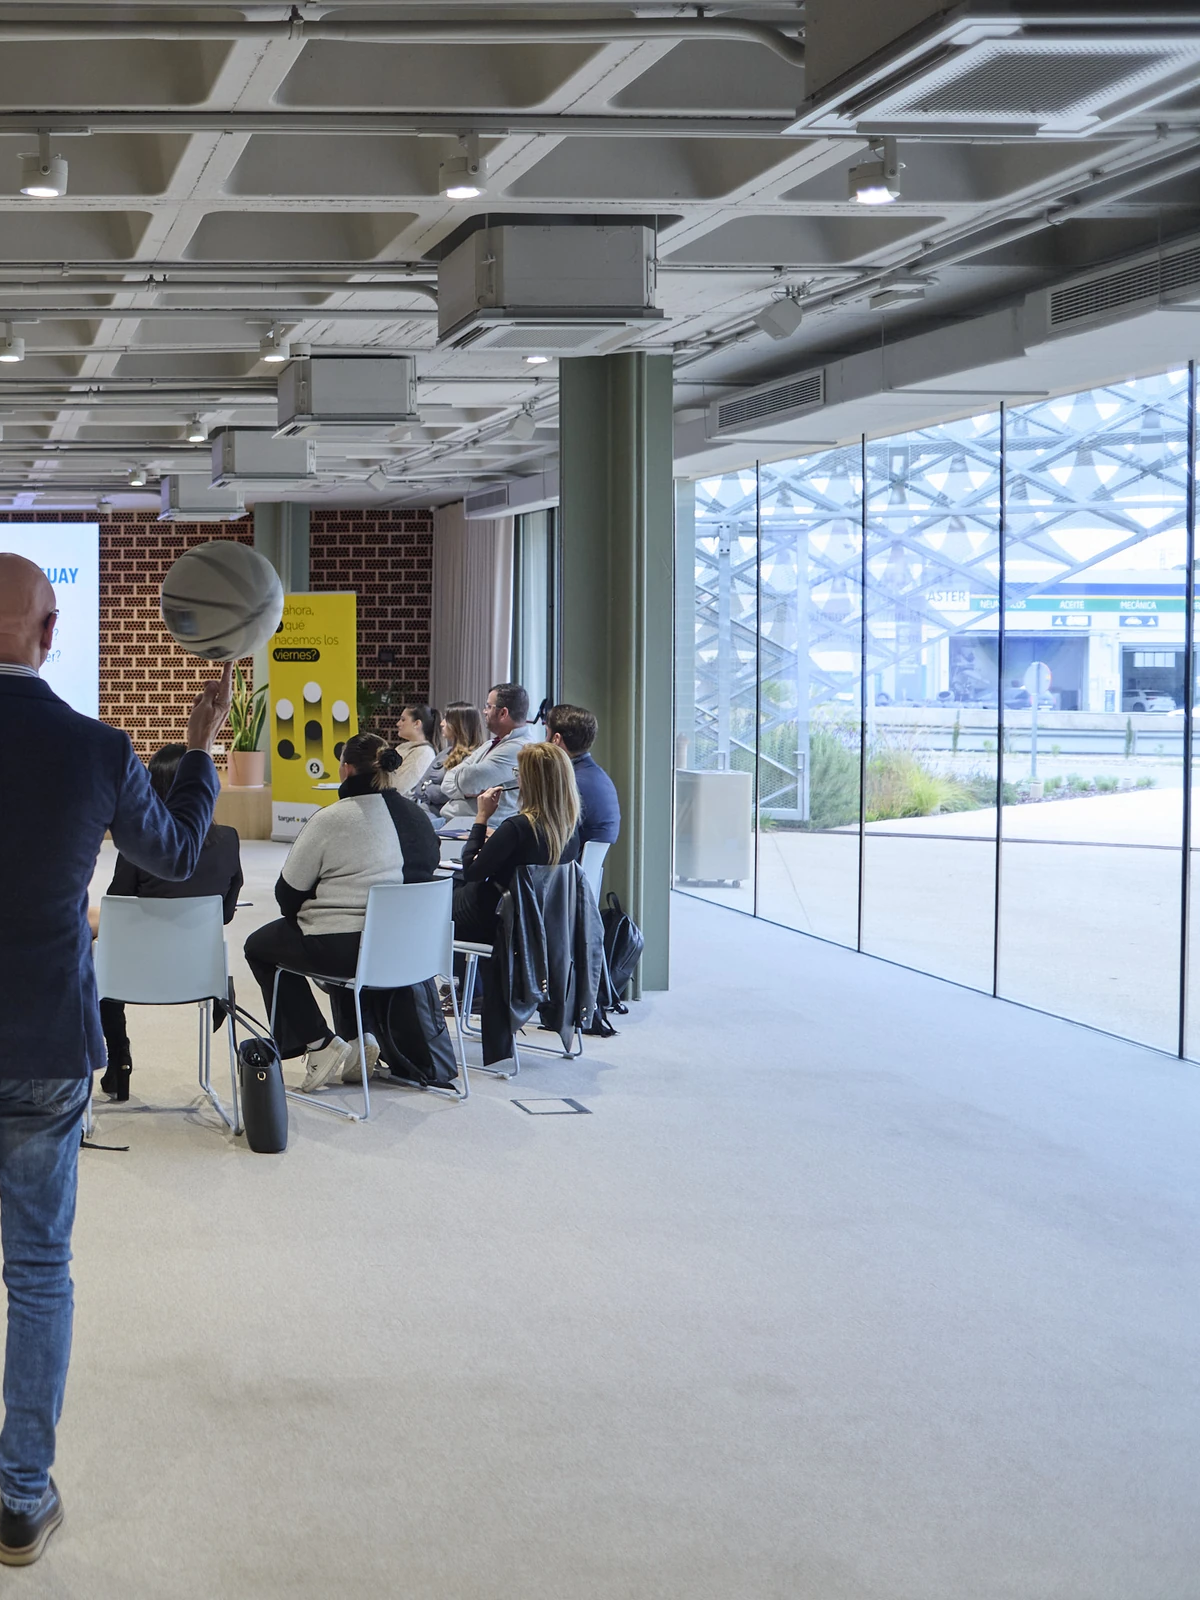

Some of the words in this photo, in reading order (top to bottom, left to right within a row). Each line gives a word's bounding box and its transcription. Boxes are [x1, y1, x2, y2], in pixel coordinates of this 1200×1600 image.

[39, 568, 79, 584] UAY
[1059, 600, 1085, 609] ACEITE
[285, 620, 305, 632] qué
[275, 635, 322, 645] hacemos
[324, 635, 339, 645] los
[275, 649, 317, 660] viernes?
[278, 815, 295, 823] target
